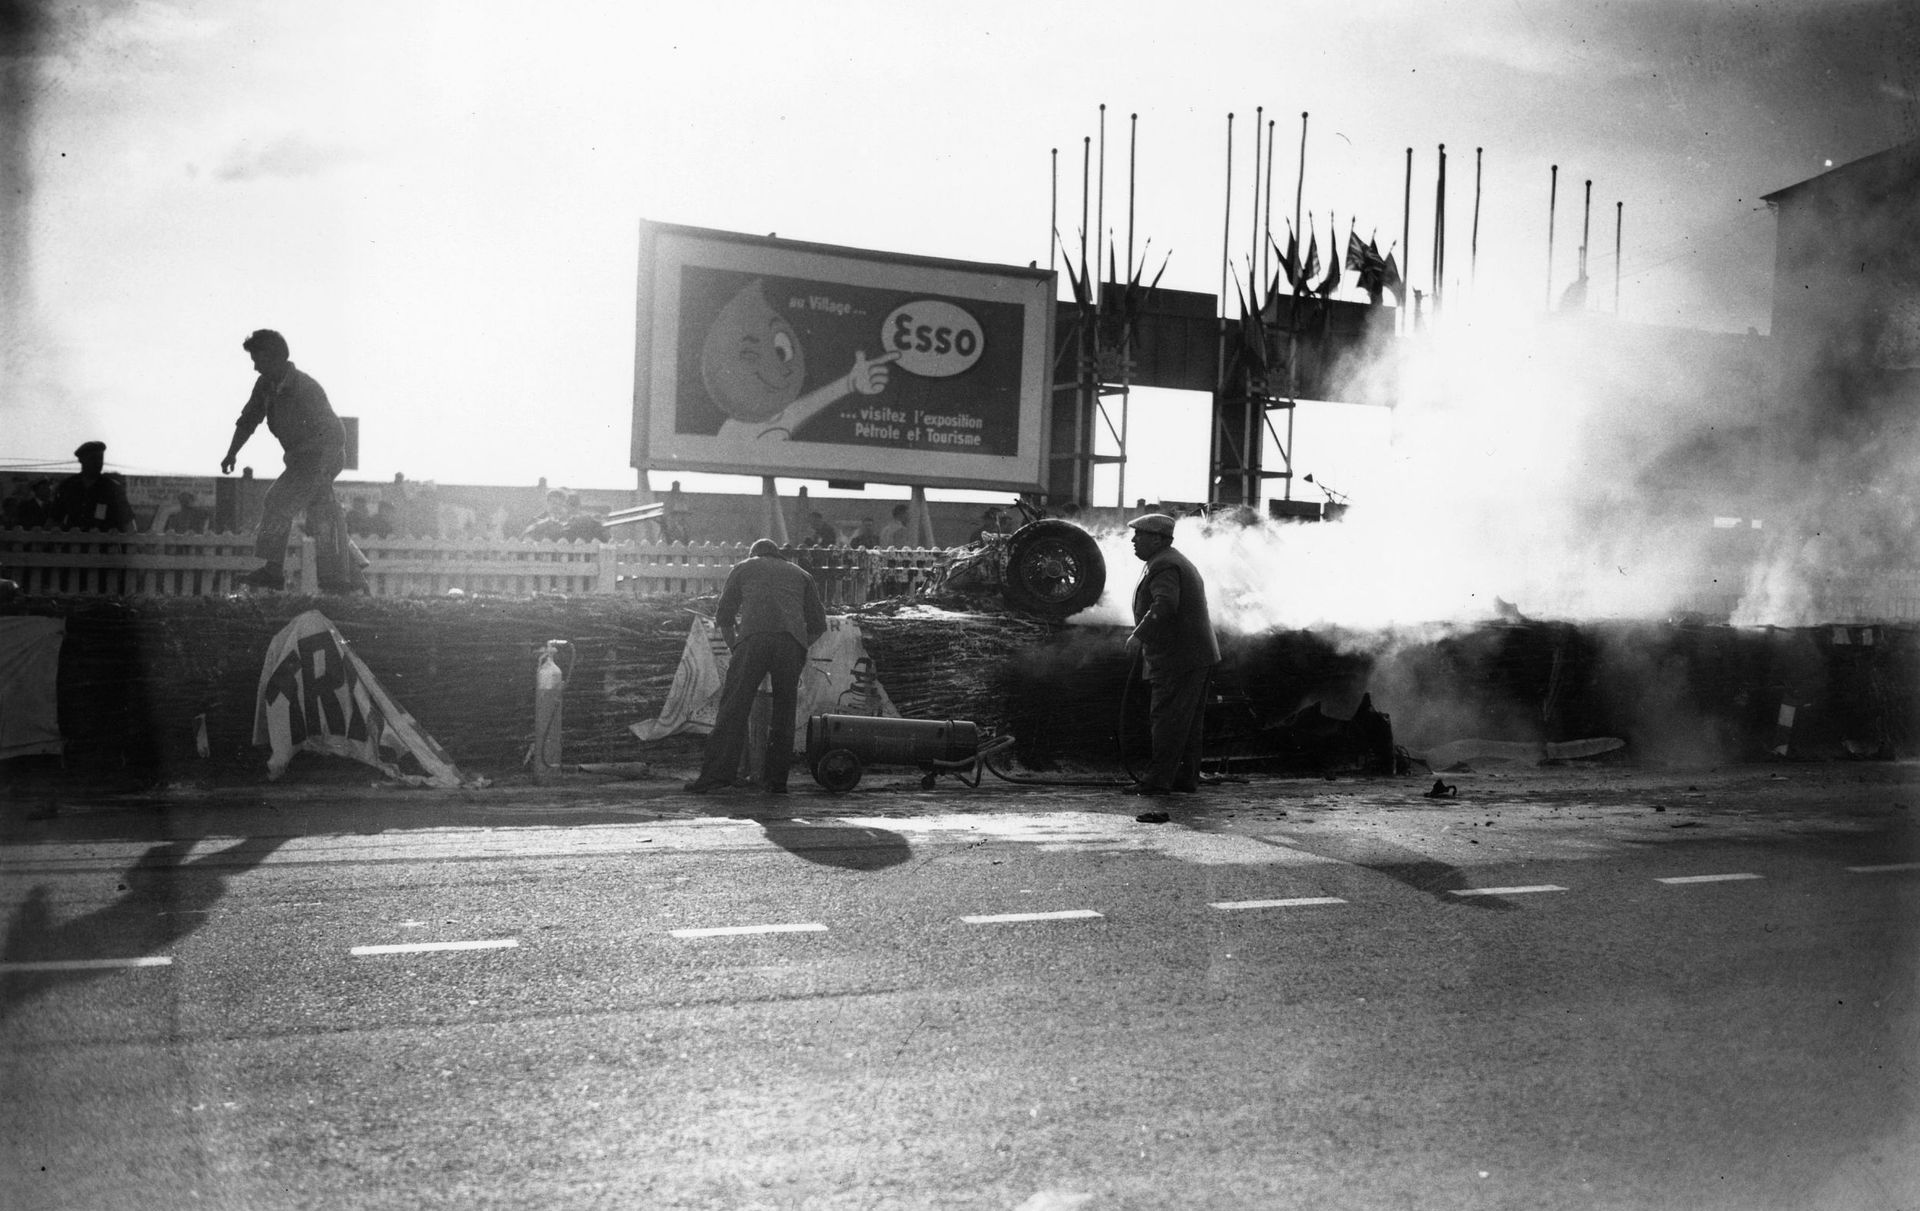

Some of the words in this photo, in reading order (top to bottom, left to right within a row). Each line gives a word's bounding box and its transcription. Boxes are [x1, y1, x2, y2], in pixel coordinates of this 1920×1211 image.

[855, 421, 901, 440] Pétrole
[907, 427, 921, 442] et
[926, 427, 982, 447] Tourisme
